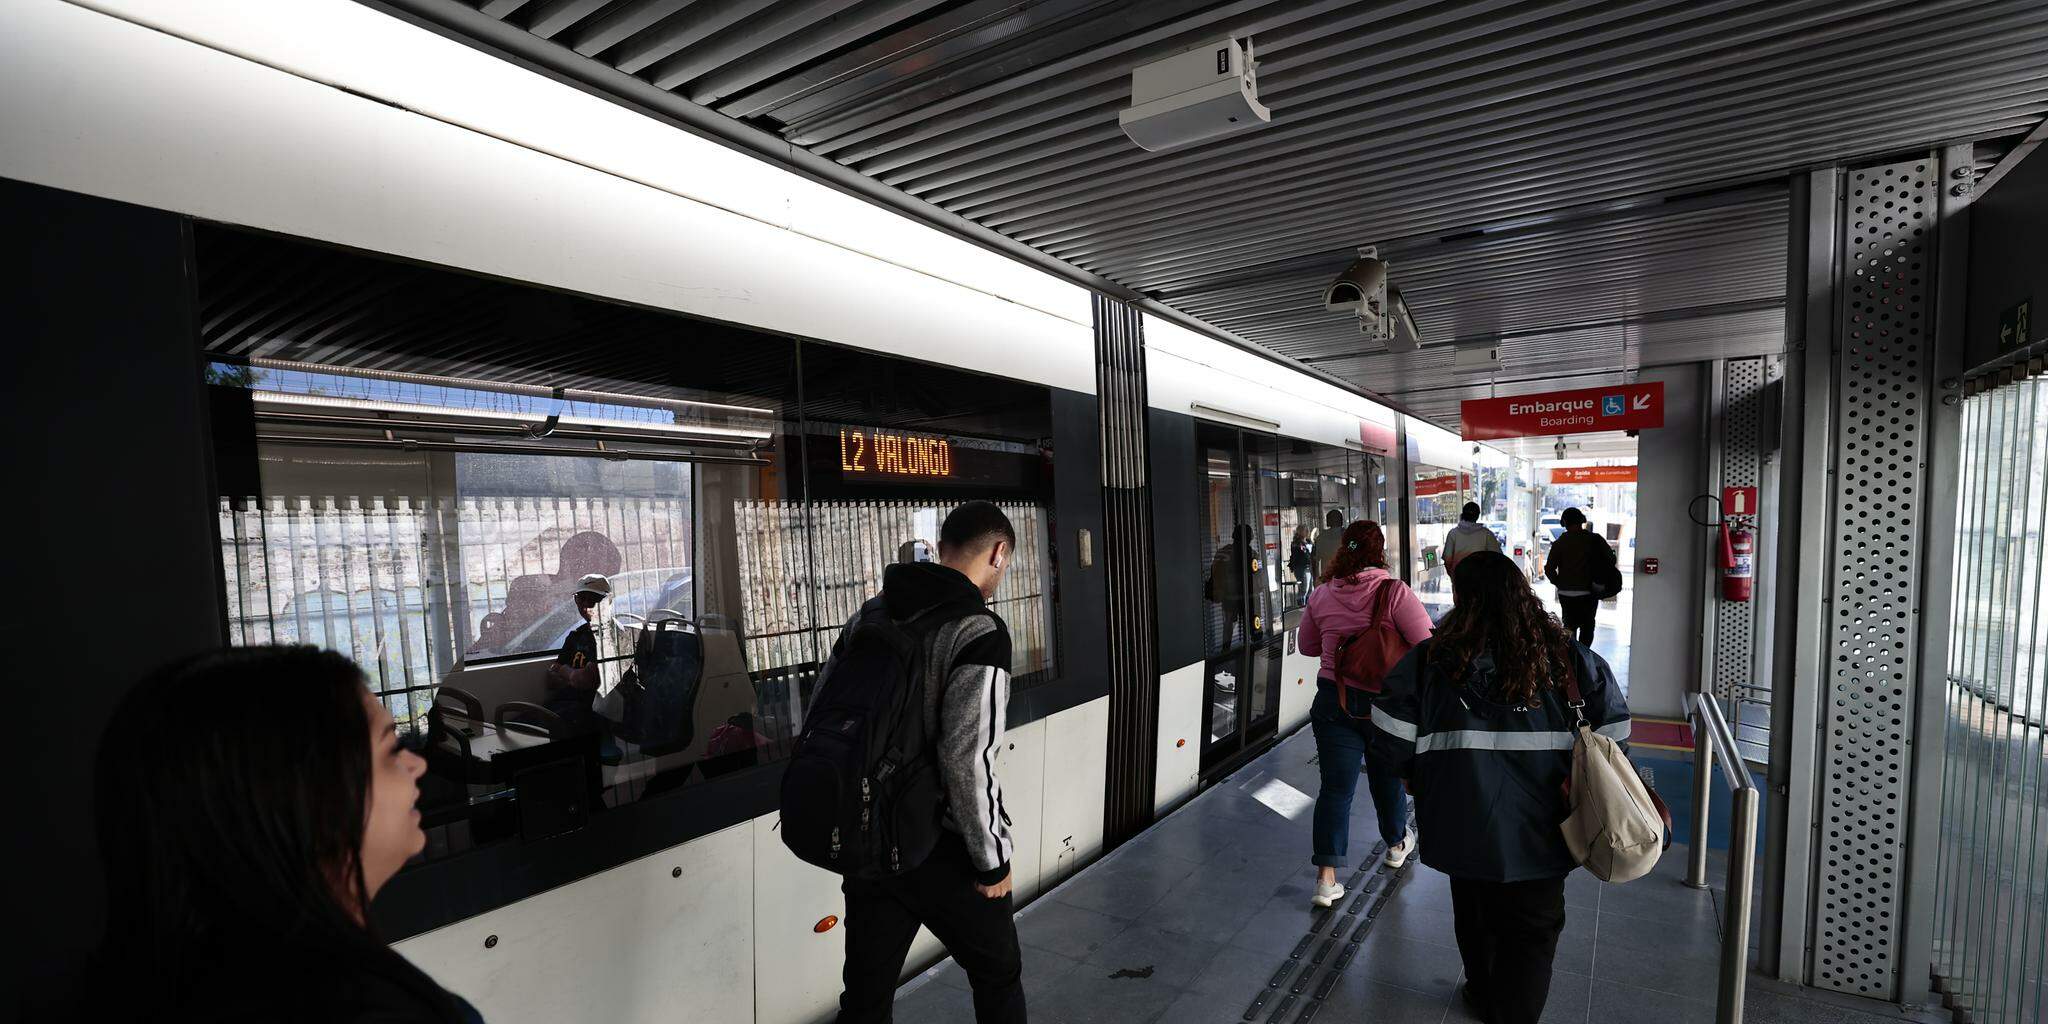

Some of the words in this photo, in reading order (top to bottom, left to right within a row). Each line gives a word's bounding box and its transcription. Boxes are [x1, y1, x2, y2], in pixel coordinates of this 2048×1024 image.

[1510, 399, 1594, 415] Embarque
[1541, 415, 1594, 427] Boarding
[841, 430, 865, 471] L2
[873, 434, 949, 475] VALONGO
